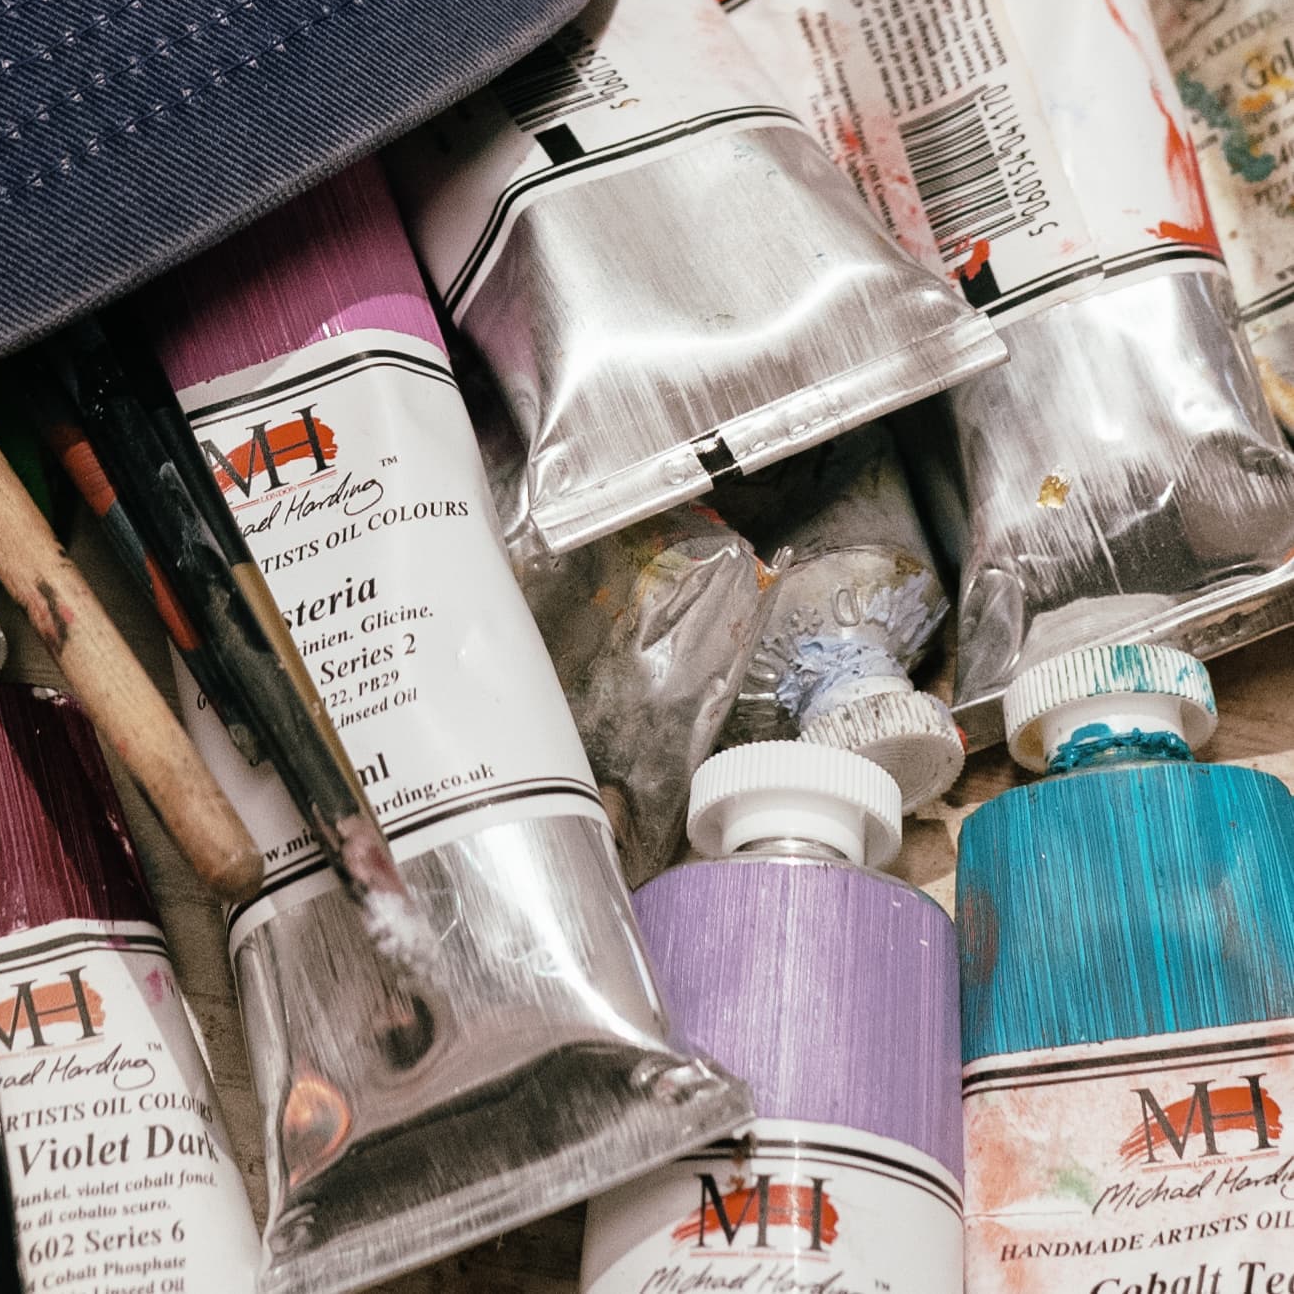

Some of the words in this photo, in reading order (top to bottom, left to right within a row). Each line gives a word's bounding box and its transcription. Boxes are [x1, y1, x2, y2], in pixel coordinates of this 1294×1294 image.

[284, 472, 385, 526] Harding
[260, 540, 320, 575] TISTS
[326, 523, 363, 550] OIL
[368, 501, 470, 532] COLOURS
[282, 576, 379, 631] steria
[300, 629, 355, 657] inien.
[361, 606, 434, 634] Glicine.
[320, 643, 394, 686] Series
[404, 633, 417, 655] 2
[358, 669, 401, 698] PB29
[393, 687, 418, 708] Oil
[356, 752, 391, 788] ml
[49, 1044, 156, 1091] Harding
[7, 1099, 86, 1131] RTISTS
[93, 1097, 132, 1119] OIL
[139, 1092, 213, 1124] COLOURS
[1130, 1073, 1279, 1165] MH
[19, 1132, 131, 1178] Violet
[146, 1124, 220, 1165] Dark
[77, 1179, 119, 1198] violet
[125, 1174, 175, 1195] cobalt
[1092, 1169, 1217, 1215] Michael
[38, 1213, 53, 1227] di
[59, 1201, 117, 1223] cobalto
[122, 1198, 172, 1218] scuro.
[28, 1233, 74, 1266] 602
[84, 1226, 163, 1255] Series
[170, 1219, 186, 1243] 6
[1000, 1233, 1144, 1263] HANDMADE
[1149, 1212, 1249, 1247] ARTISTS
[42, 1265, 98, 1288] Cobalt
[103, 1256, 187, 1277] Phosphate
[161, 1277, 184, 1294] Oil
